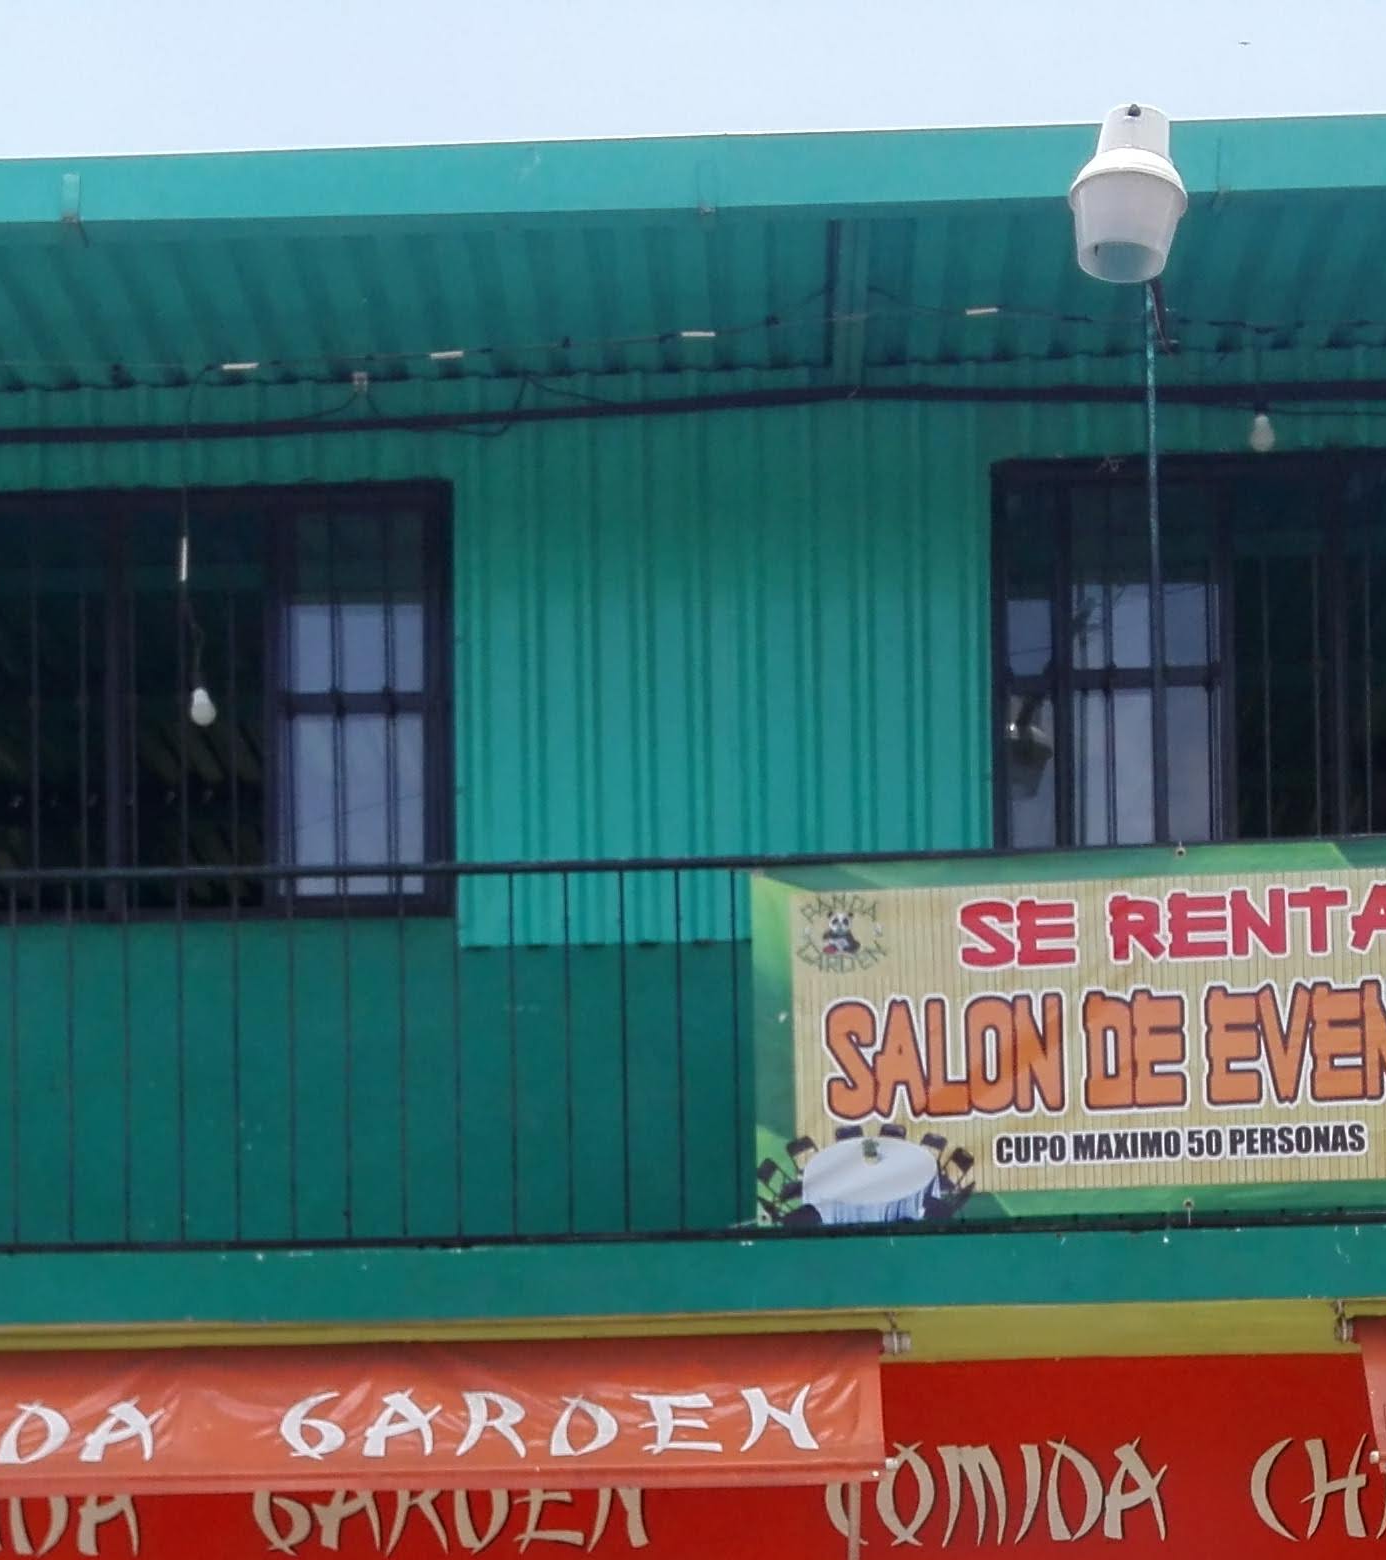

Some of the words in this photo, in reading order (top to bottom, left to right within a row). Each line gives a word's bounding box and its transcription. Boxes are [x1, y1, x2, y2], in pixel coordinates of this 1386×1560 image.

[959, 899, 1076, 966] SE
[825, 992, 1065, 1119] SALON
[1083, 988, 1188, 1108] DE
[996, 1134, 1065, 1164] CUPO
[1074, 1131, 1180, 1161] MAXIMO
[1188, 1128, 1222, 1158] 50
[1229, 1124, 1365, 1156] PERSONAS
[278, 1382, 819, 1462] GARDEN
